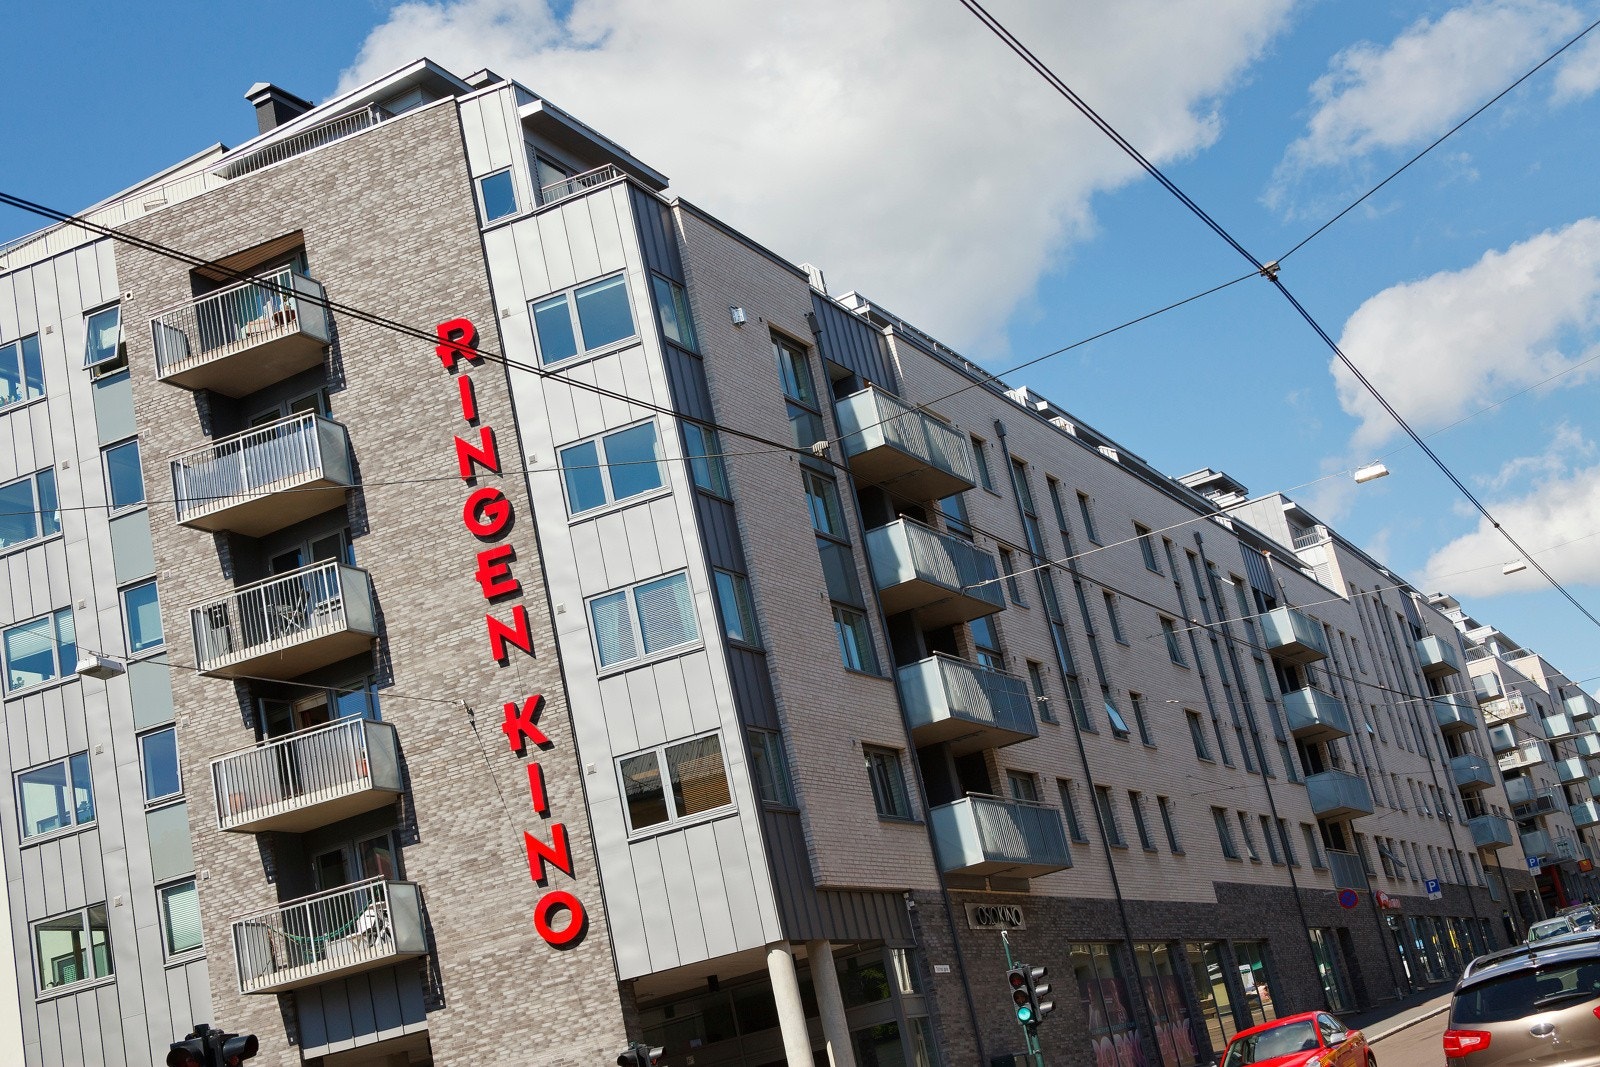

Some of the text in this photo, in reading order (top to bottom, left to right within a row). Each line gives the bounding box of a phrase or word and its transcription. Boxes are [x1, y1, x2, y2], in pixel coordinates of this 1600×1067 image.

[436, 318, 583, 944] RINGEN KINO
[1428, 881, 1436, 892] P
